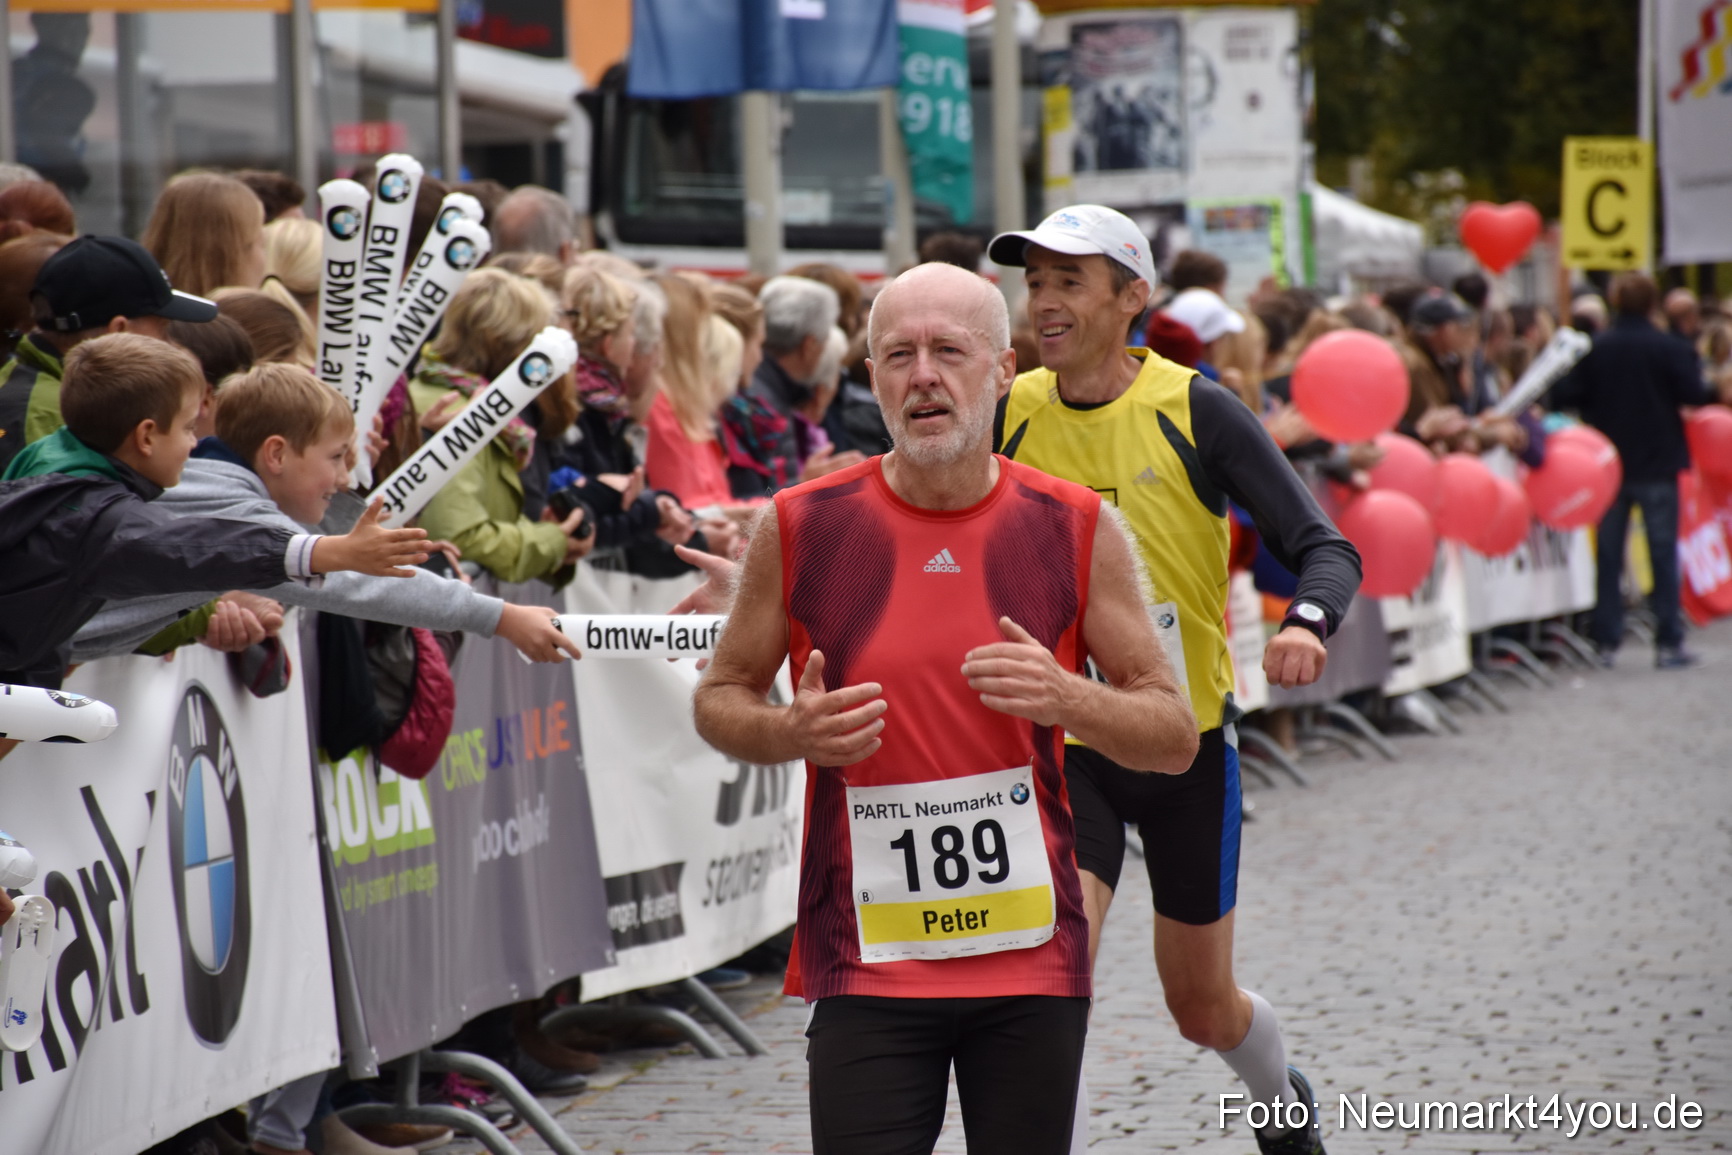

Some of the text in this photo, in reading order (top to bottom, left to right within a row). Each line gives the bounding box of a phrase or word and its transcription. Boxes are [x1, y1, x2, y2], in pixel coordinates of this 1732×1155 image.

[1587, 180, 1625, 237] C
[324, 259, 357, 335] BMW
[360, 225, 398, 307] BMW
[390, 279, 448, 355] BMW
[442, 388, 514, 460] BMW
[924, 564, 961, 573] adidas
[170, 693, 237, 811] BMW
[853, 791, 1004, 820] PARTL Neumarkt
[890, 818, 1010, 893] 189
[862, 891, 870, 903] B
[922, 908, 989, 934] Peter
